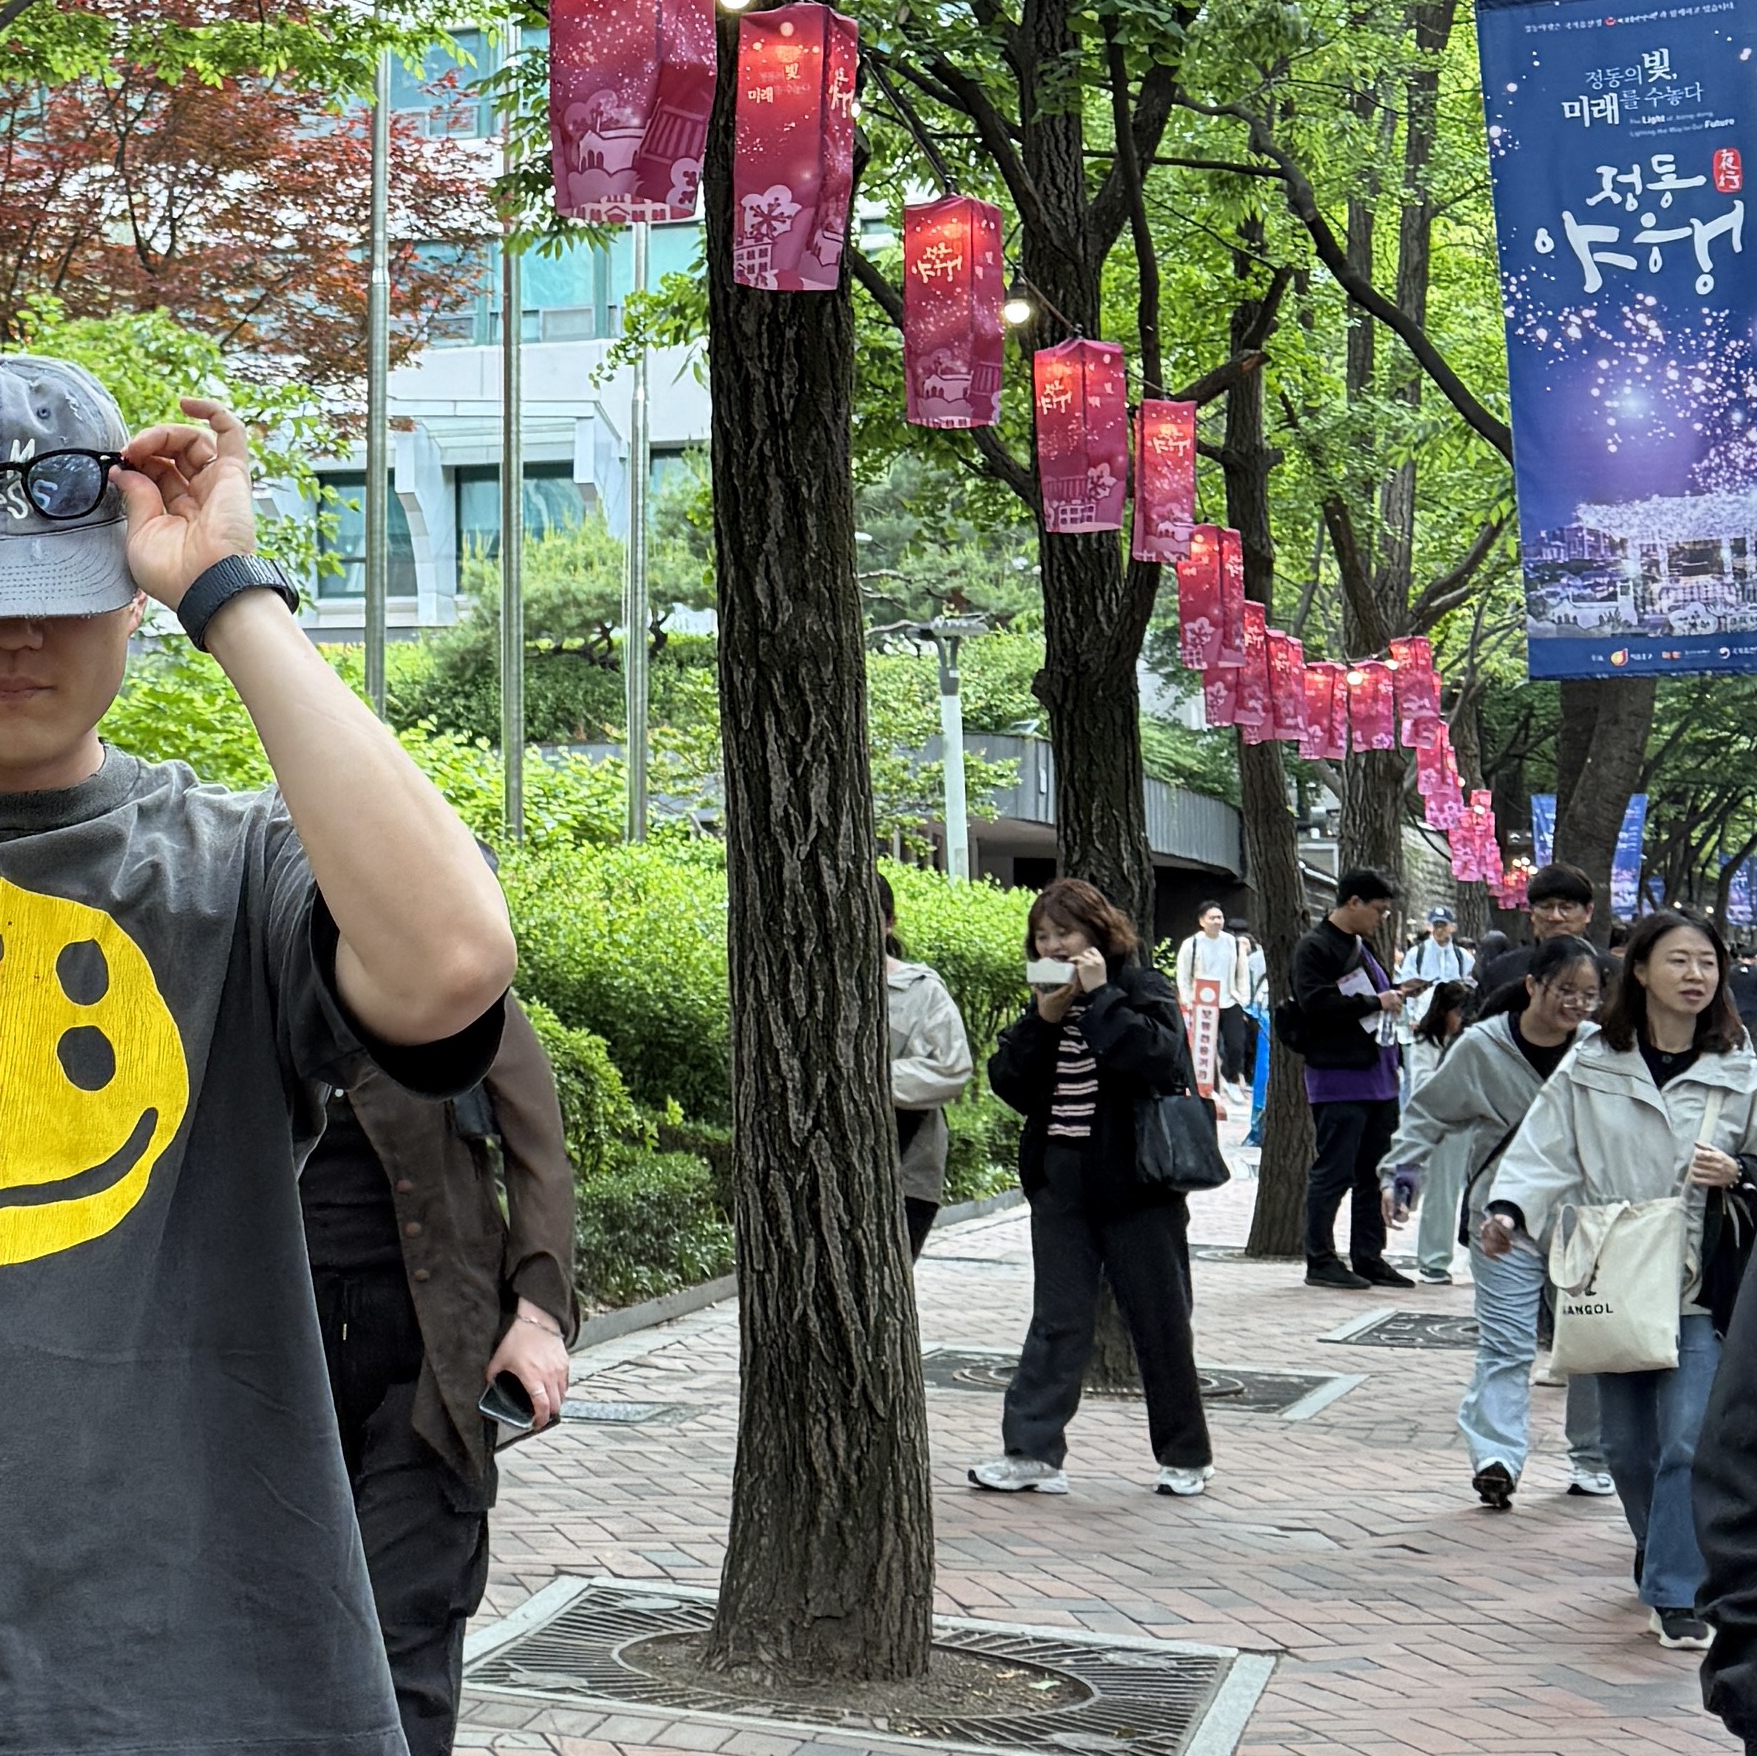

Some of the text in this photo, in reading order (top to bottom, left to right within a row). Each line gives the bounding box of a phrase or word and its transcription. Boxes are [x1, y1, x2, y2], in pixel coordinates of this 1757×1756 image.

[1585, 48, 1678, 90] 정동의 빛,
[1561, 81, 1705, 128] 미래를 수놓다
[1585, 154, 1707, 212] 정동
[1534, 200, 1744, 295] 야행
